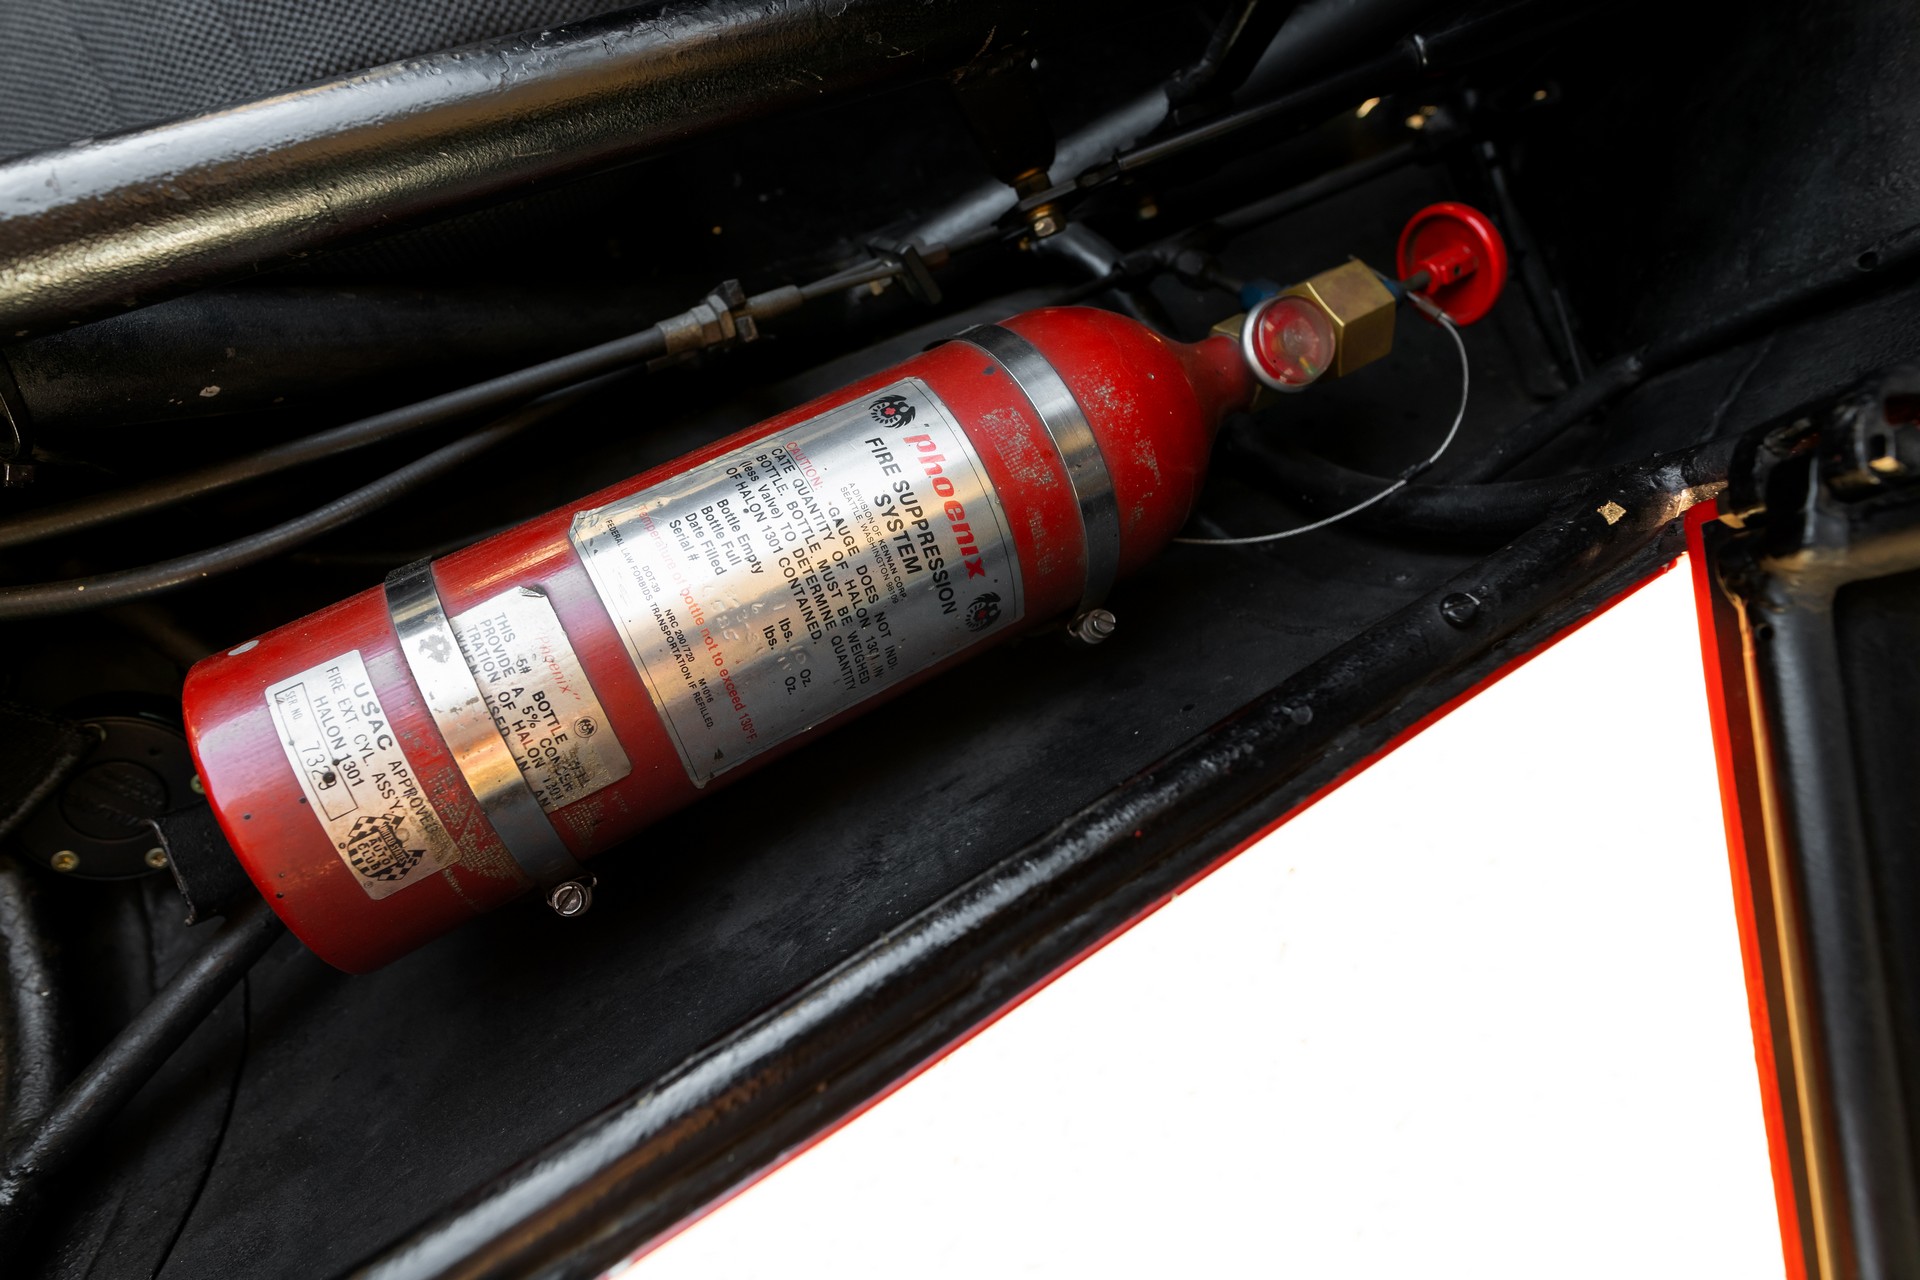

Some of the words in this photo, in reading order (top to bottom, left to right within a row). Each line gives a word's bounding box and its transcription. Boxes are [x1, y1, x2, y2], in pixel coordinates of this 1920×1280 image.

[604, 518, 625, 547] FEDERAL
[700, 505, 728, 540] Bottle
[720, 540, 742, 566] Full
[864, 436, 902, 476] FIRE
[890, 478, 958, 615] SUPPRESSION
[871, 492, 923, 575] SYSTEM
[902, 429, 987, 579] phoenix
[620, 547, 634, 565] LAW
[633, 504, 678, 570] Temperature
[668, 518, 694, 552] Serial
[686, 552, 700, 562] #
[684, 512, 706, 539] Date
[700, 539, 727, 576] Filled
[715, 498, 743, 532] Bottle
[736, 533, 766, 576] Empty
[724, 466, 742, 481] OF
[734, 480, 767, 523] HALON
[760, 524, 783, 554] 1301
[776, 555, 825, 644] CONTAINED.
[755, 454, 790, 495] BOTTLE.
[816, 558, 843, 600] MUST
[836, 605, 853, 626] BE
[846, 630, 870, 685] WEIGHED
[770, 447, 795, 474] CATE
[791, 477, 835, 543] QUANTITY
[829, 549, 849, 572] OF
[843, 579, 871, 629] HALON
[784, 440, 823, 490] CAUTION:
[826, 505, 860, 557] GAUGE
[855, 564, 879, 604] DOES
[874, 611, 891, 640] NOT
[839, 485, 864, 523] SEATTLE,
[859, 522, 890, 581] WASHINGTON
[885, 581, 900, 604] 98109
[847, 480, 856, 489] A
[852, 488, 874, 524] DIVISION
[870, 524, 882, 538] OF
[877, 538, 898, 575] KENNAN
[892, 575, 907, 601] CORP.
[629, 564, 654, 601] FORBIDS
[671, 570, 687, 586] of
[679, 586, 707, 626] bottle
[738, 460, 760, 481] (less
[756, 483, 784, 520] Valve)
[778, 521, 797, 543] TO
[791, 546, 837, 631] DETERMINE
[829, 634, 856, 692] QUANTITY
[641, 564, 661, 593] DOT-39
[663, 608, 679, 629] NRC
[673, 628, 695, 663] 200/720
[697, 677, 714, 703] M1016
[648, 601, 692, 680] TRANSPORTATION
[699, 626, 718, 651] not
[710, 651, 726, 668] to
[761, 624, 780, 650] lbs.
[777, 617, 796, 642] lbs.
[464, 624, 502, 684] TRATION
[496, 689, 516, 714] OF
[511, 719, 546, 769] HALON
[478, 618, 516, 678] PROVIDE
[510, 684, 526, 697] A
[520, 704, 542, 729] 5%
[493, 611, 516, 643] THIS
[514, 657, 532, 676] 5#
[531, 690, 568, 745] BOTTLE
[687, 680, 697, 691] IF
[717, 667, 746, 711] exceed
[783, 675, 798, 695] Oz.
[798, 667, 813, 688] Oz.
[312, 694, 347, 751] HALON
[337, 752, 365, 788] 1301
[325, 665, 346, 694] FIRE
[336, 696, 361, 729] EXT.
[352, 732, 378, 766] CYL.
[370, 770, 404, 813] ASS'Y.
[351, 682, 395, 752] USAC
[691, 690, 715, 730] REFILLED.
[356, 841, 380, 871] CLUB
[368, 837, 391, 866] AUTO
[378, 823, 396, 845] UNITED
[389, 843, 407, 865] STATES
